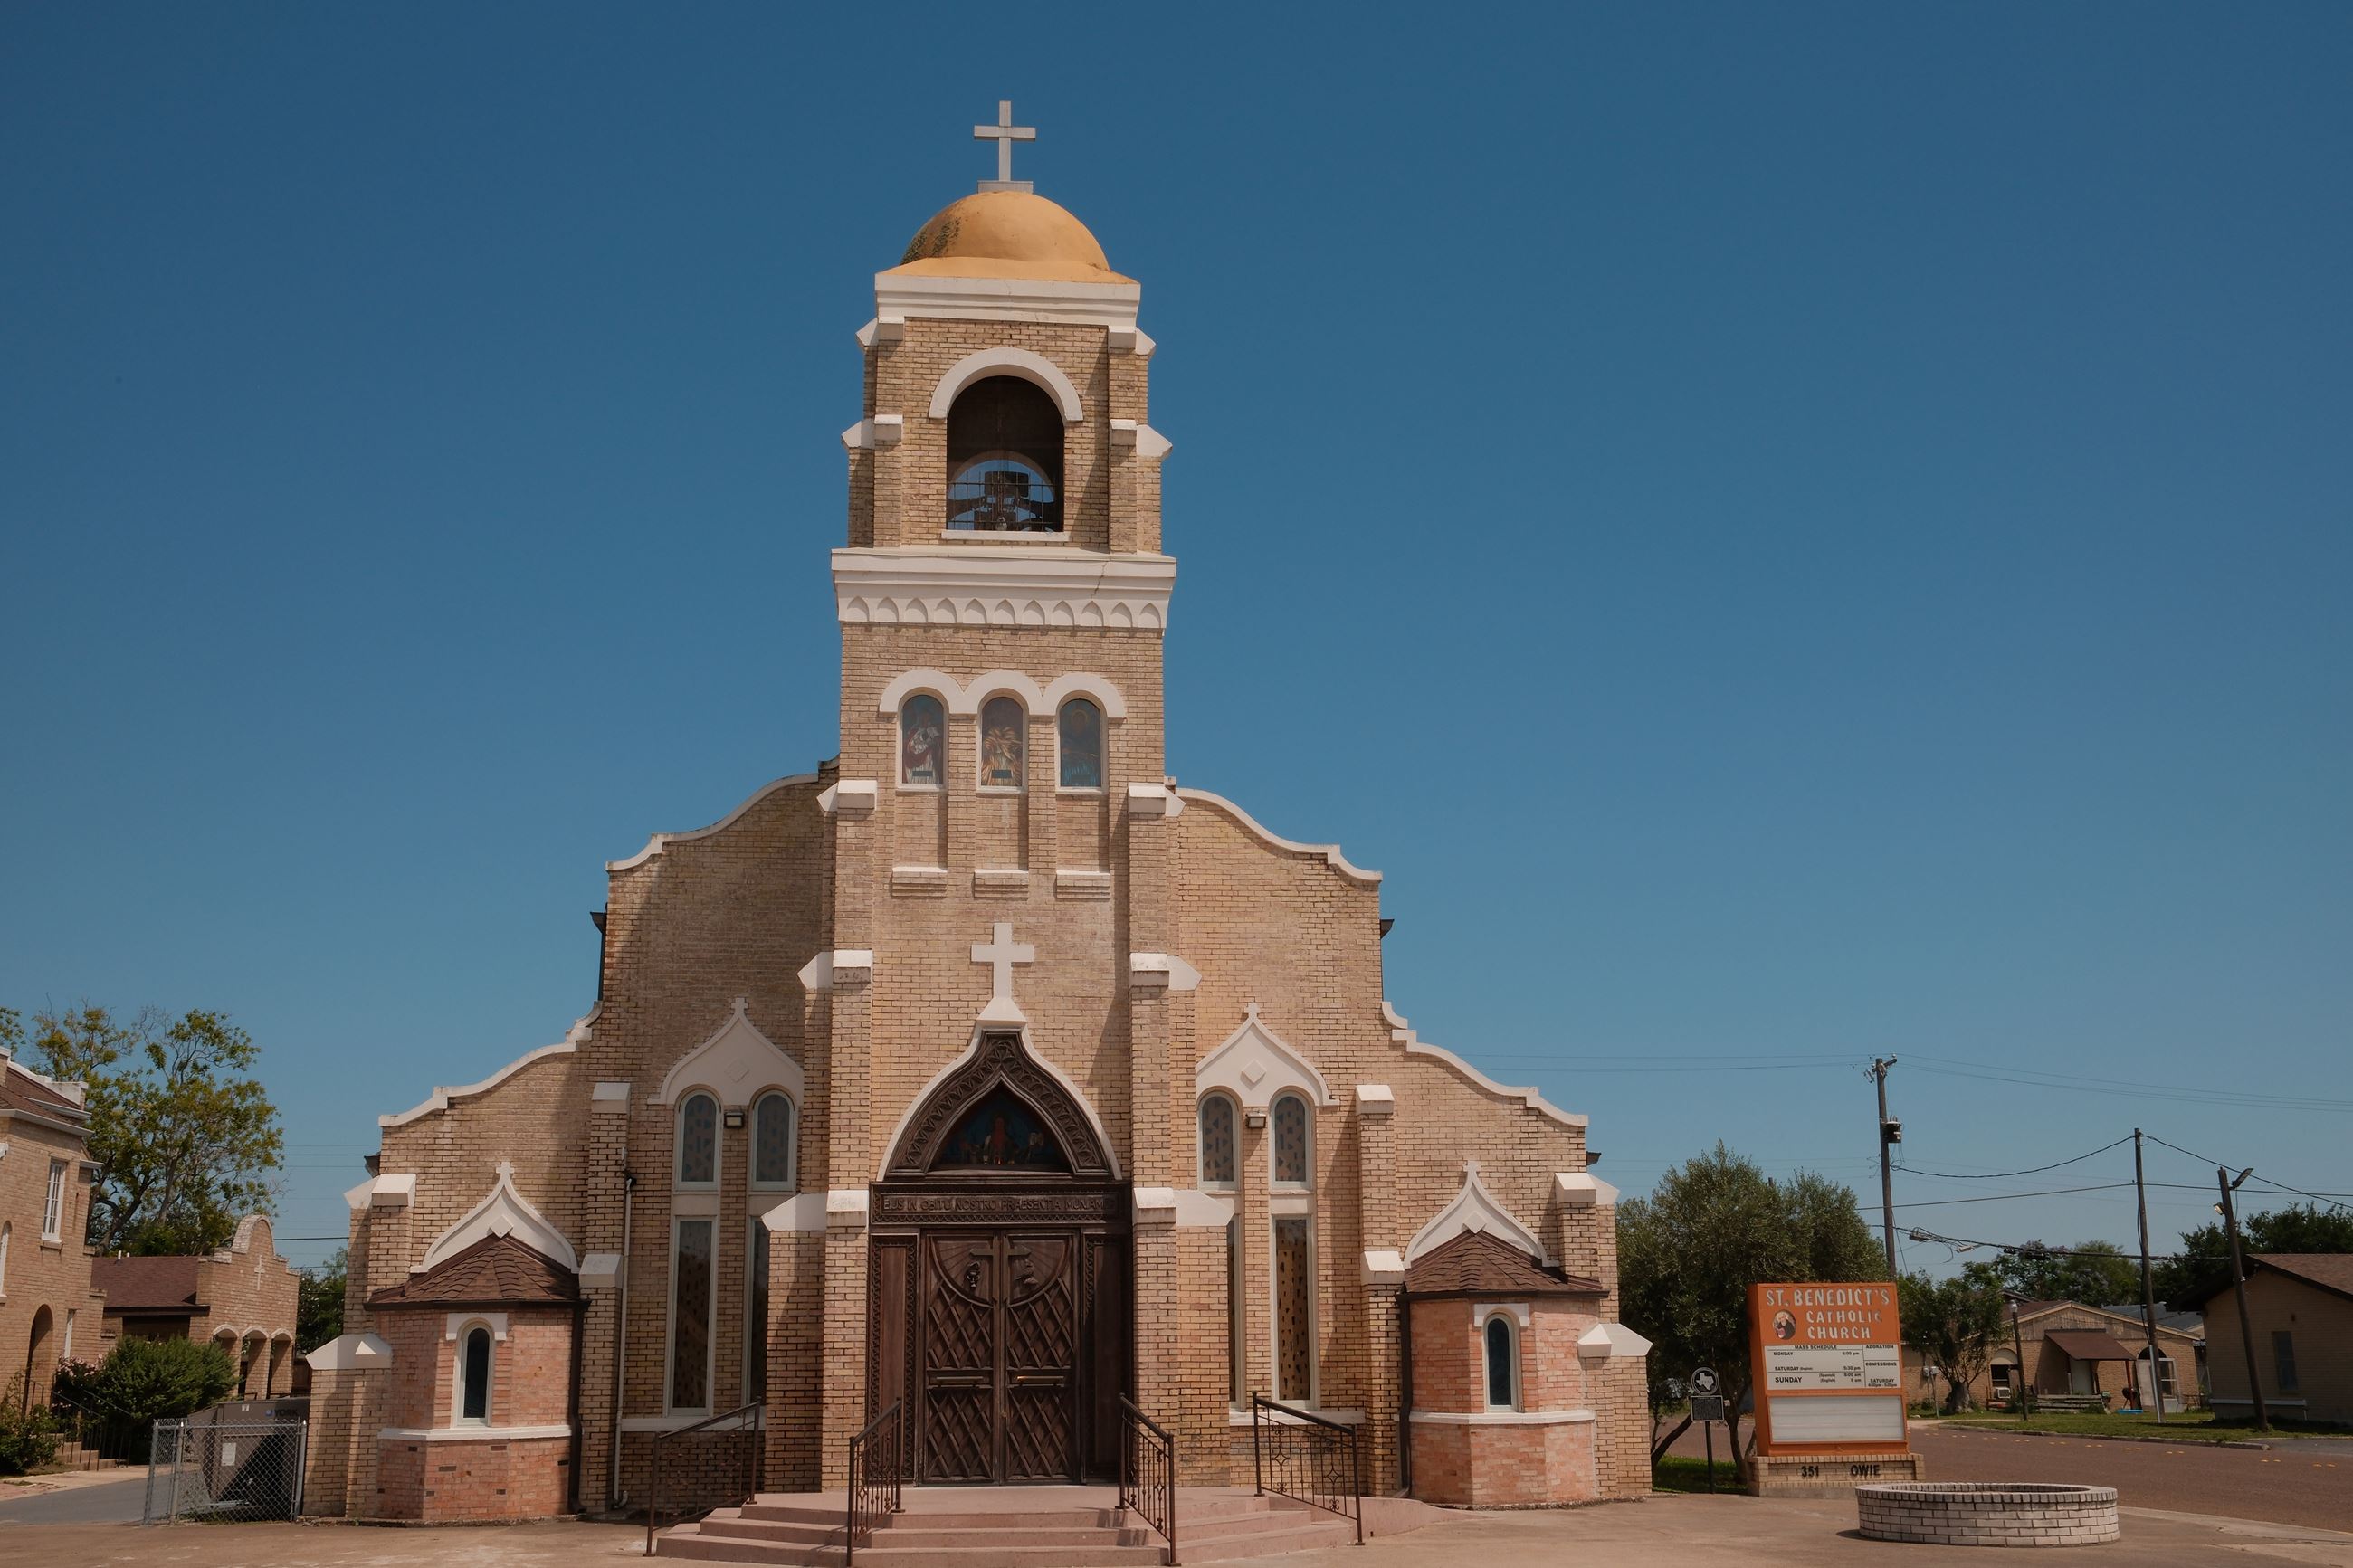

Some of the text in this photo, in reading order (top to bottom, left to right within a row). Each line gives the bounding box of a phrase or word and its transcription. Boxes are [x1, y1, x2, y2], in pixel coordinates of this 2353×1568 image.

[883, 1198, 904, 1211] EIUS
[907, 1198, 918, 1211] IN
[920, 1198, 951, 1211] OBITU
[955, 1198, 997, 1211] NOSTRO
[1000, 1198, 1061, 1211] PRAESENTIA
[1766, 1288, 1890, 1307] ST. BENEDICT'S
[1806, 1310, 1883, 1323] CATHOLIC
[1807, 1326, 1871, 1339] CHURCH
[1801, 1465, 1819, 1477] 351
